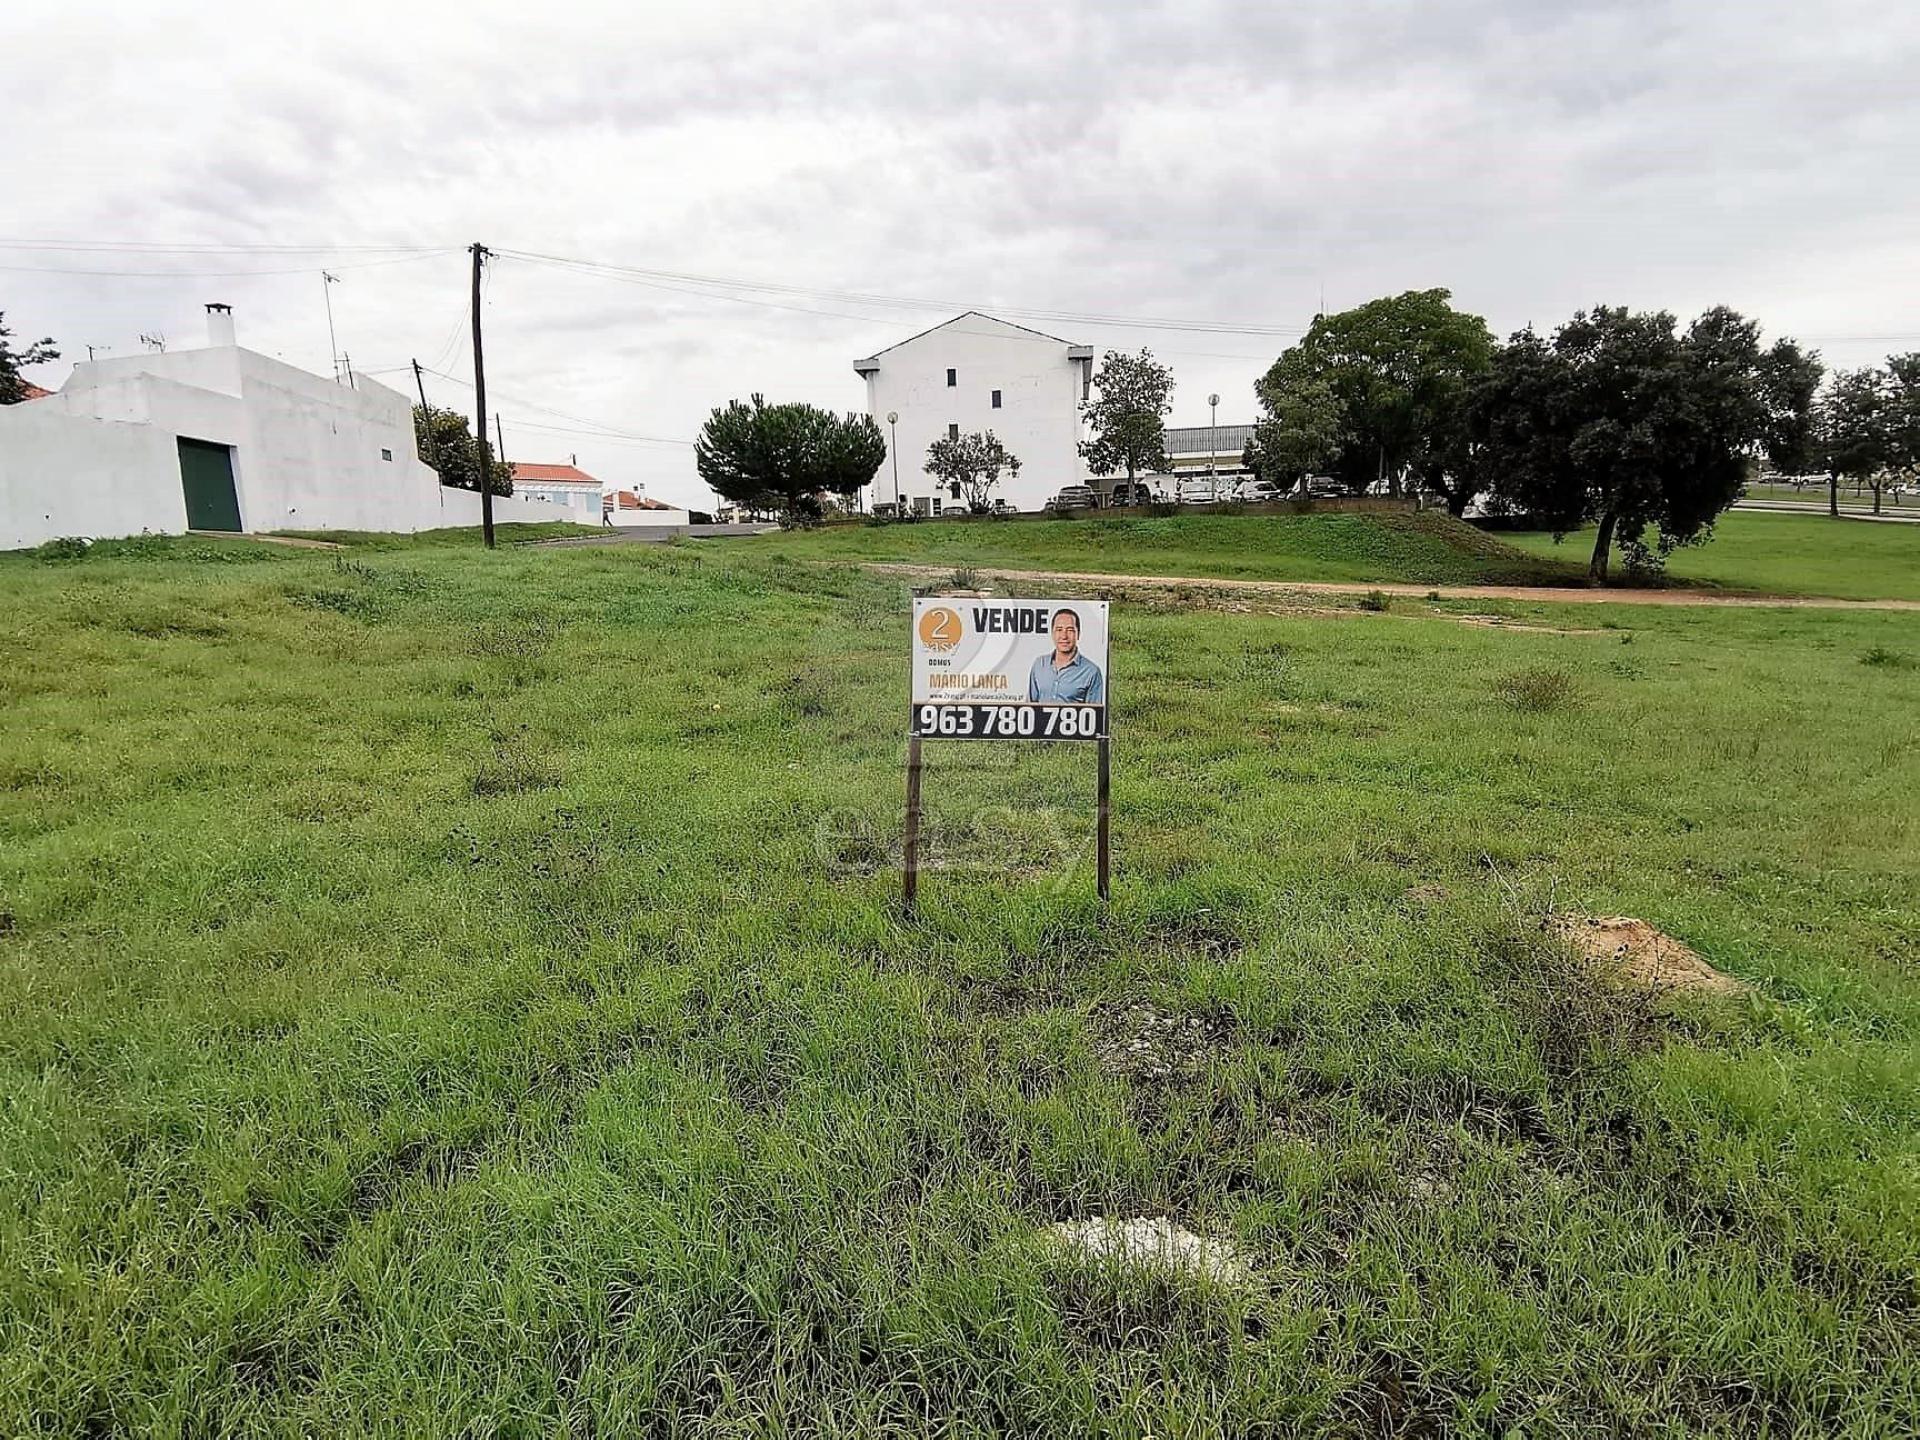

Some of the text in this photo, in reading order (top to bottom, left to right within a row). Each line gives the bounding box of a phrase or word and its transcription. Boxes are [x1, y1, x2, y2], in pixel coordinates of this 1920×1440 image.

[931, 610, 950, 639] 2
[973, 608, 1049, 633] VENDE
[929, 670, 1009, 692] MÁRIO LANÇA
[920, 706, 1096, 736] 963 780 780
